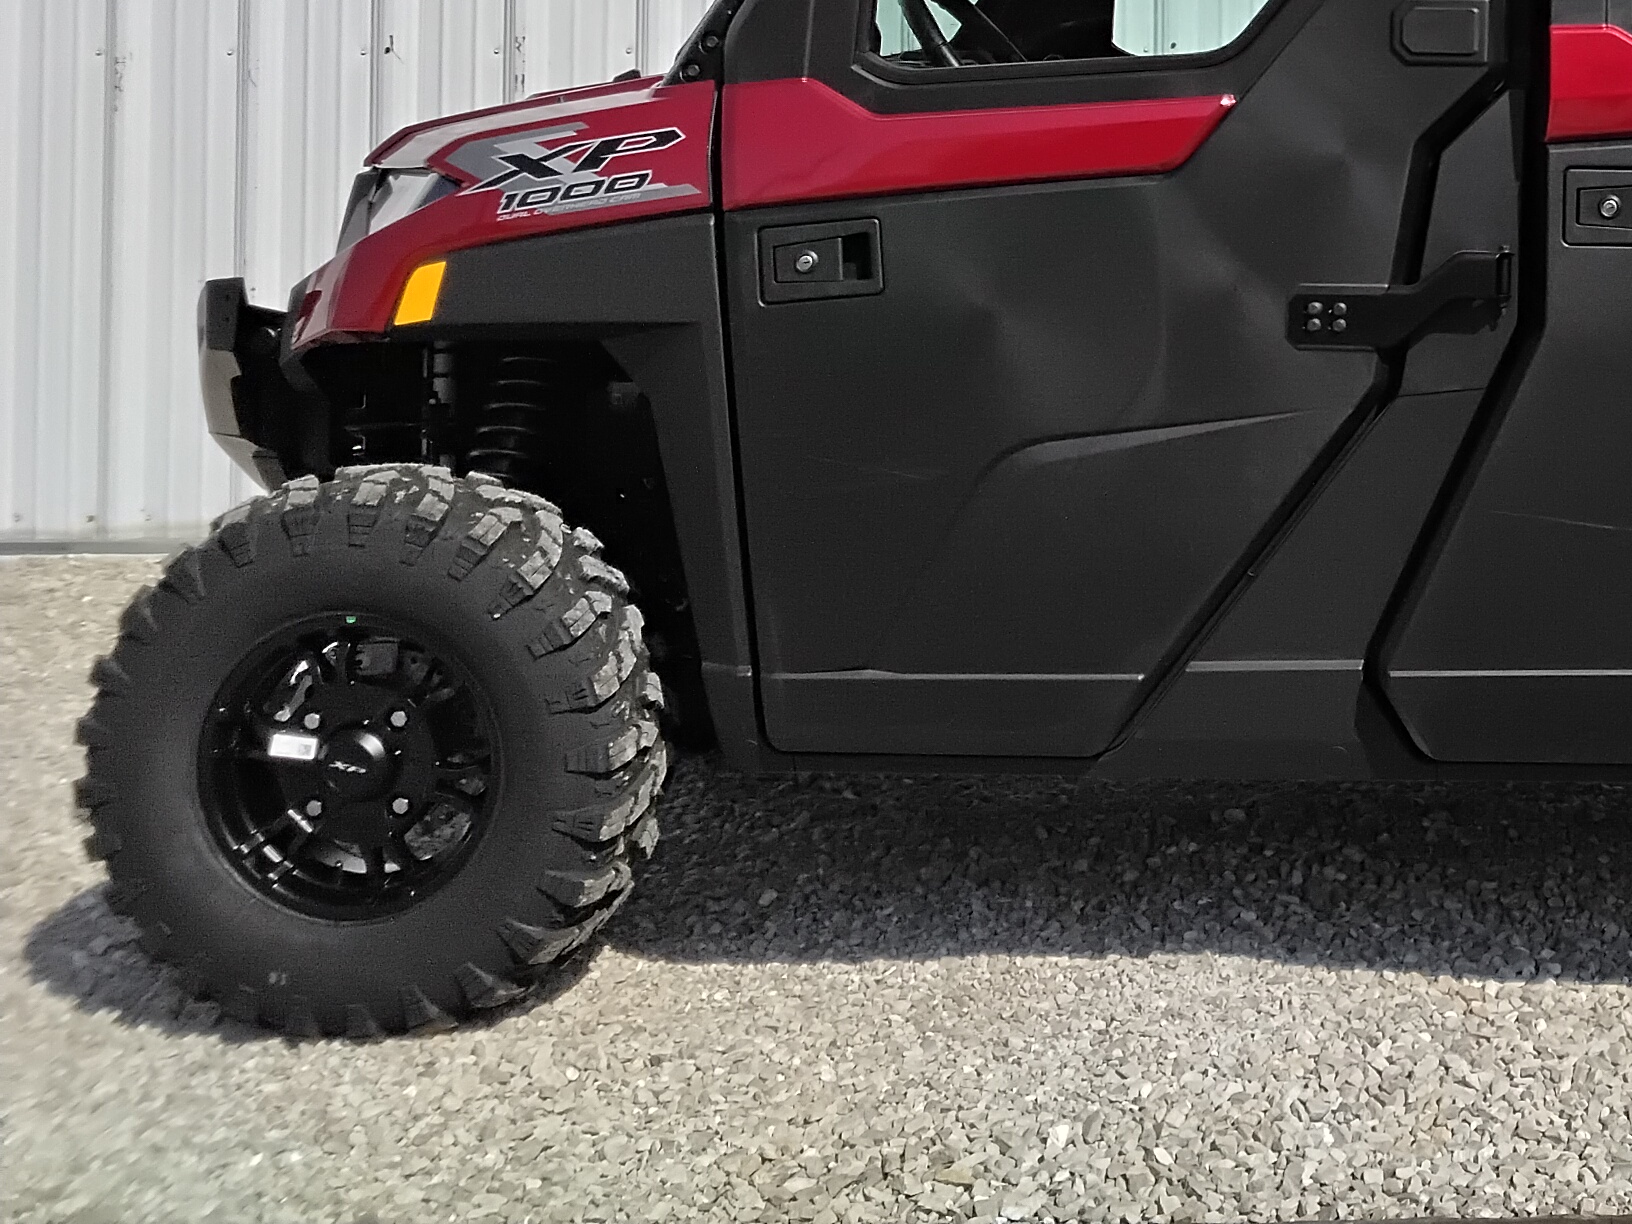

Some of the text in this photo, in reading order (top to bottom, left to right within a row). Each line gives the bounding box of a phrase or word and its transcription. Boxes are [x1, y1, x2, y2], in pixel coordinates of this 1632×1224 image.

[457, 127, 686, 196] XP
[497, 170, 652, 214] 1000
[496, 210, 532, 221] DUAL
